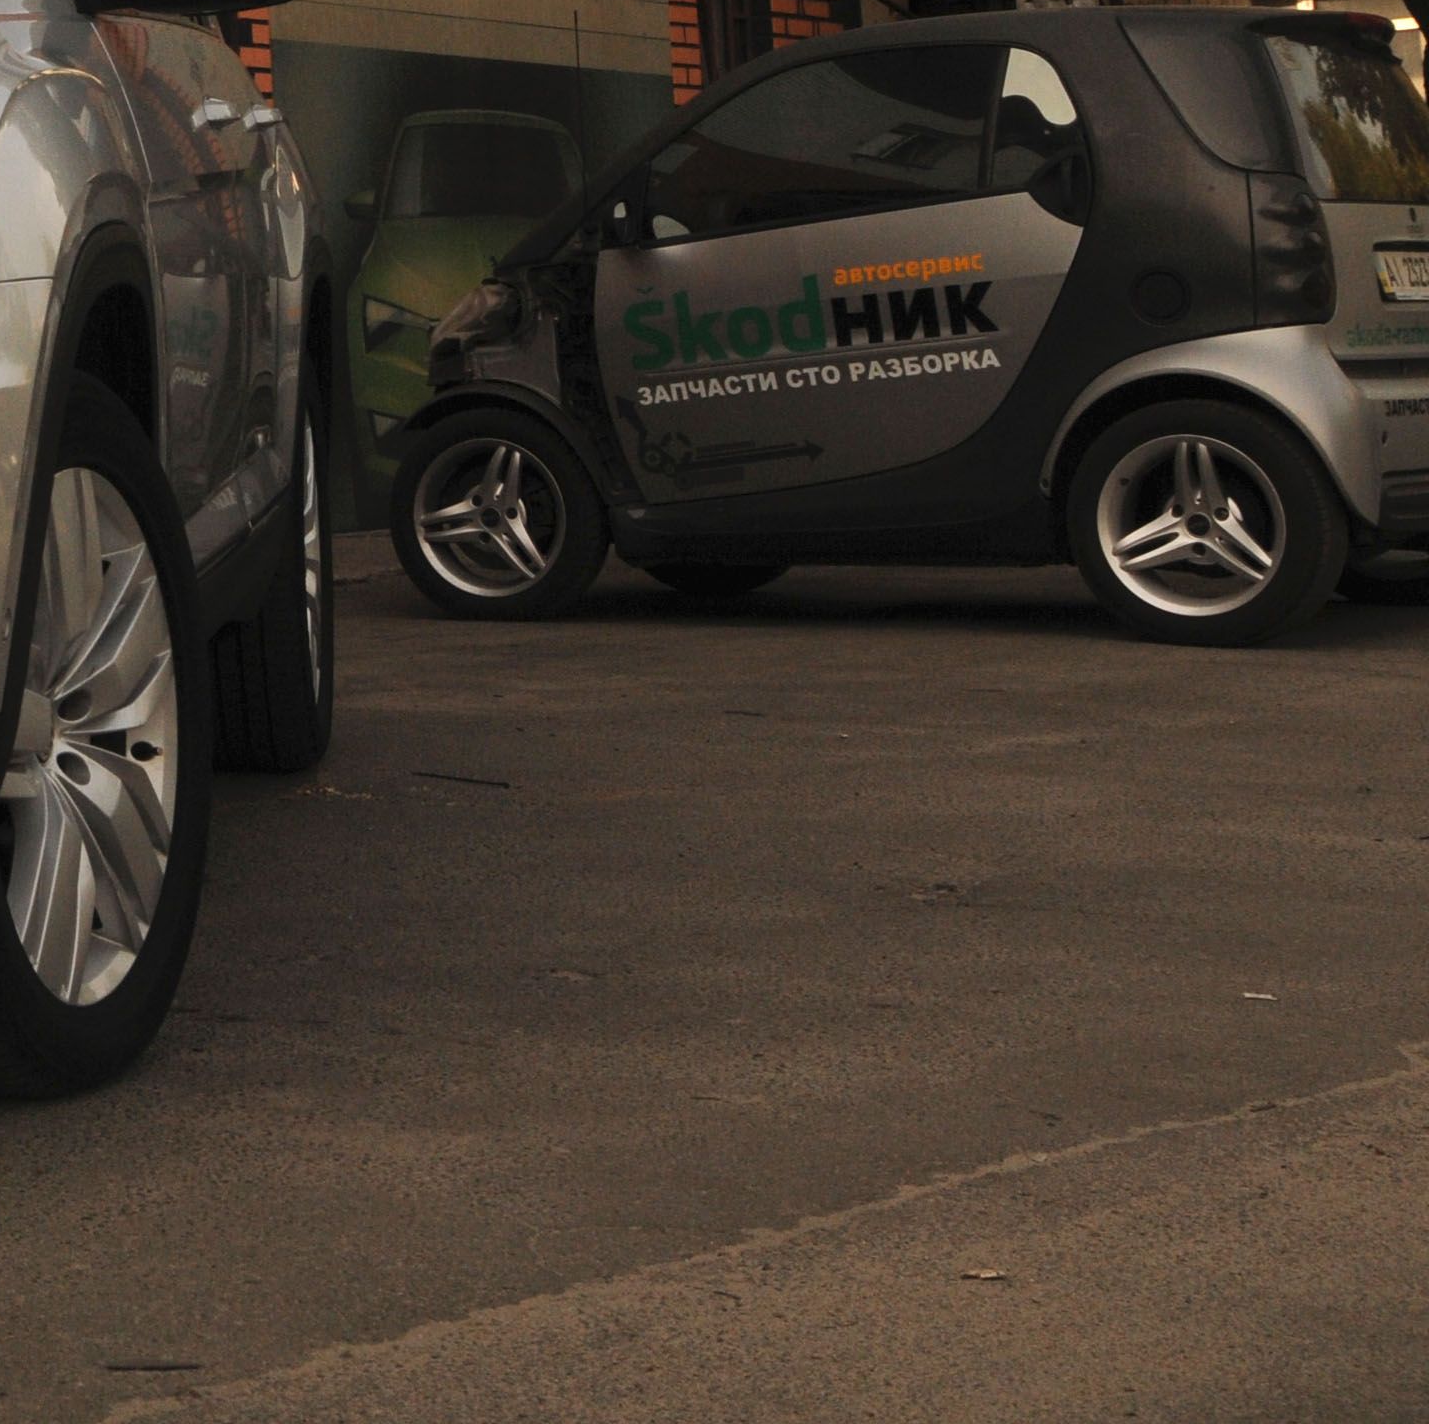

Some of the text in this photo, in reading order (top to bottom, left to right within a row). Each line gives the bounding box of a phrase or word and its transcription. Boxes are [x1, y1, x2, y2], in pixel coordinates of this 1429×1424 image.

[833, 253, 984, 286] автосервис
[637, 348, 1002, 407] ЗАПЧАСТИ СТО РАЗБОРКА
